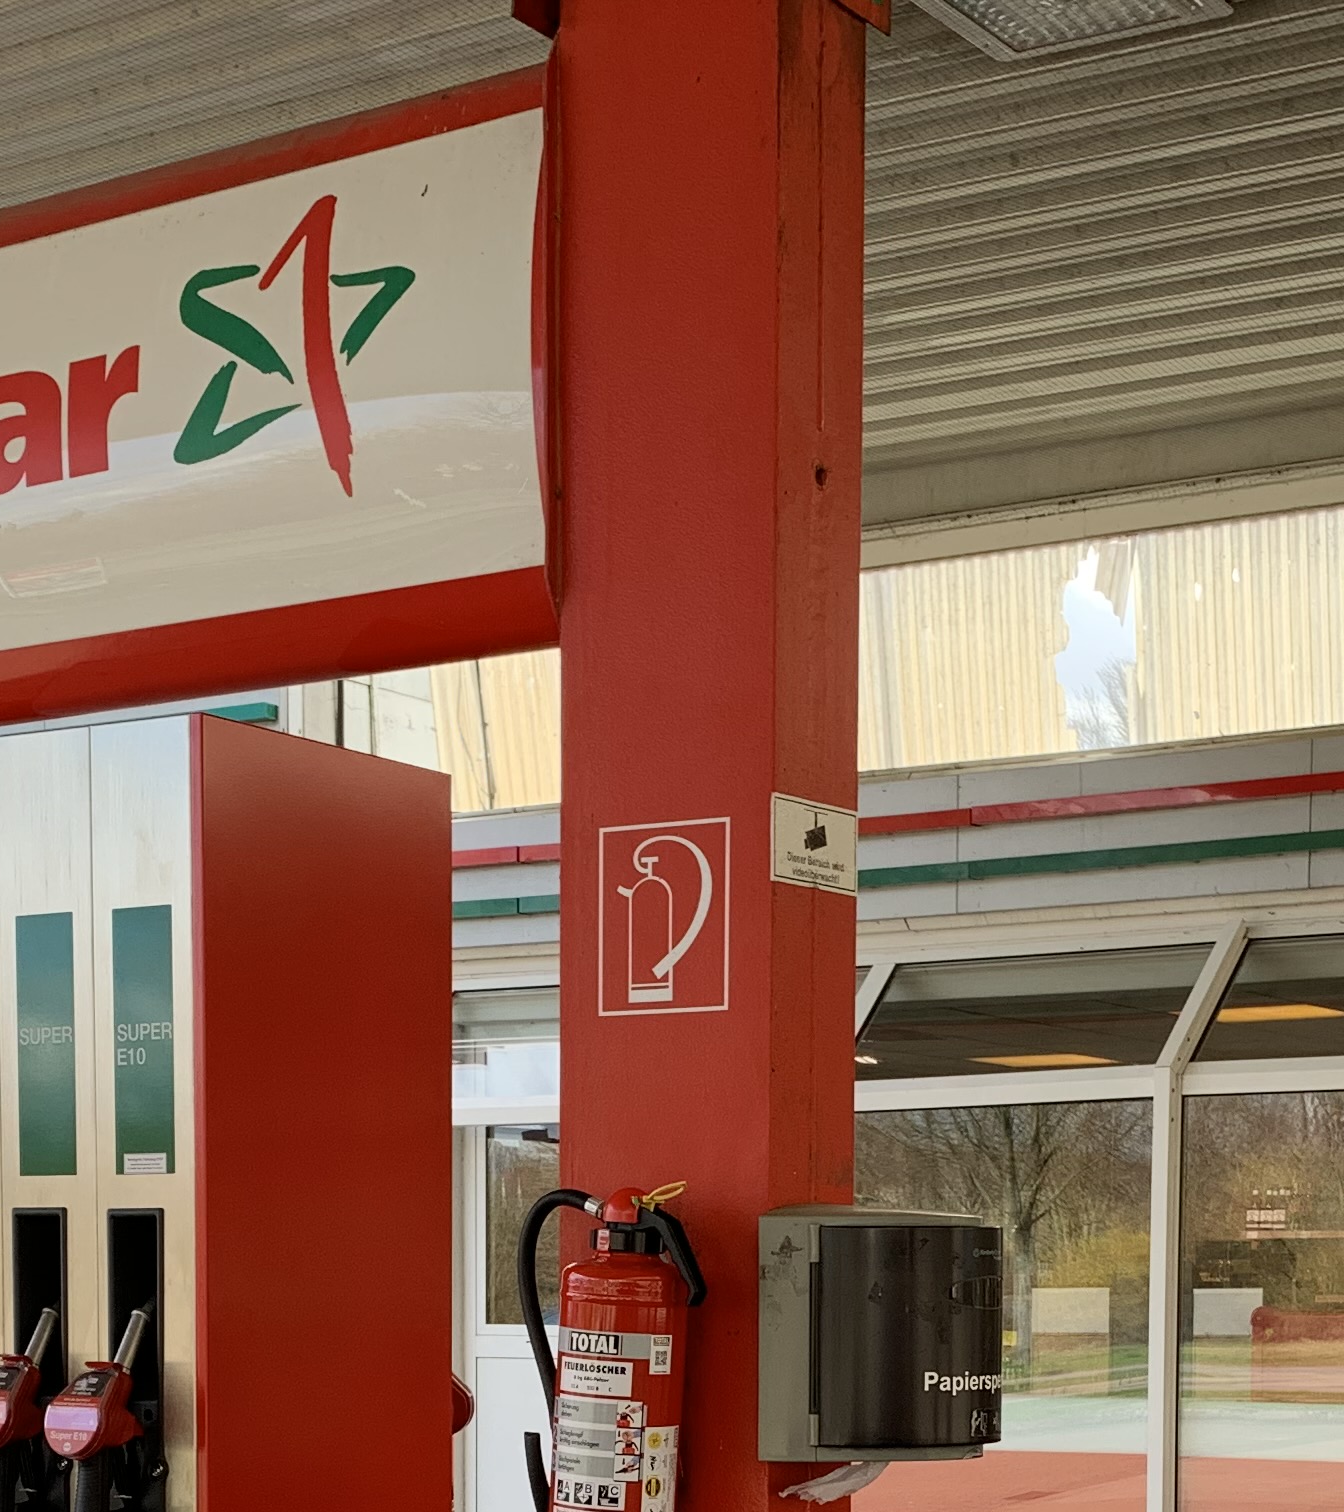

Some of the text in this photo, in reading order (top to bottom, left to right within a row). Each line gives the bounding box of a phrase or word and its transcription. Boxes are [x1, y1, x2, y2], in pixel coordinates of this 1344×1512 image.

[19, 1026, 73, 1045] SUPER
[117, 1022, 173, 1042] SUPER
[117, 1048, 146, 1066] E10
[571, 1332, 618, 1354] TOTAL
[564, 1361, 627, 1375] FEUERLÖSCHER
[50, 1430, 72, 1440] Super
[610, 1486, 619, 1496] C
